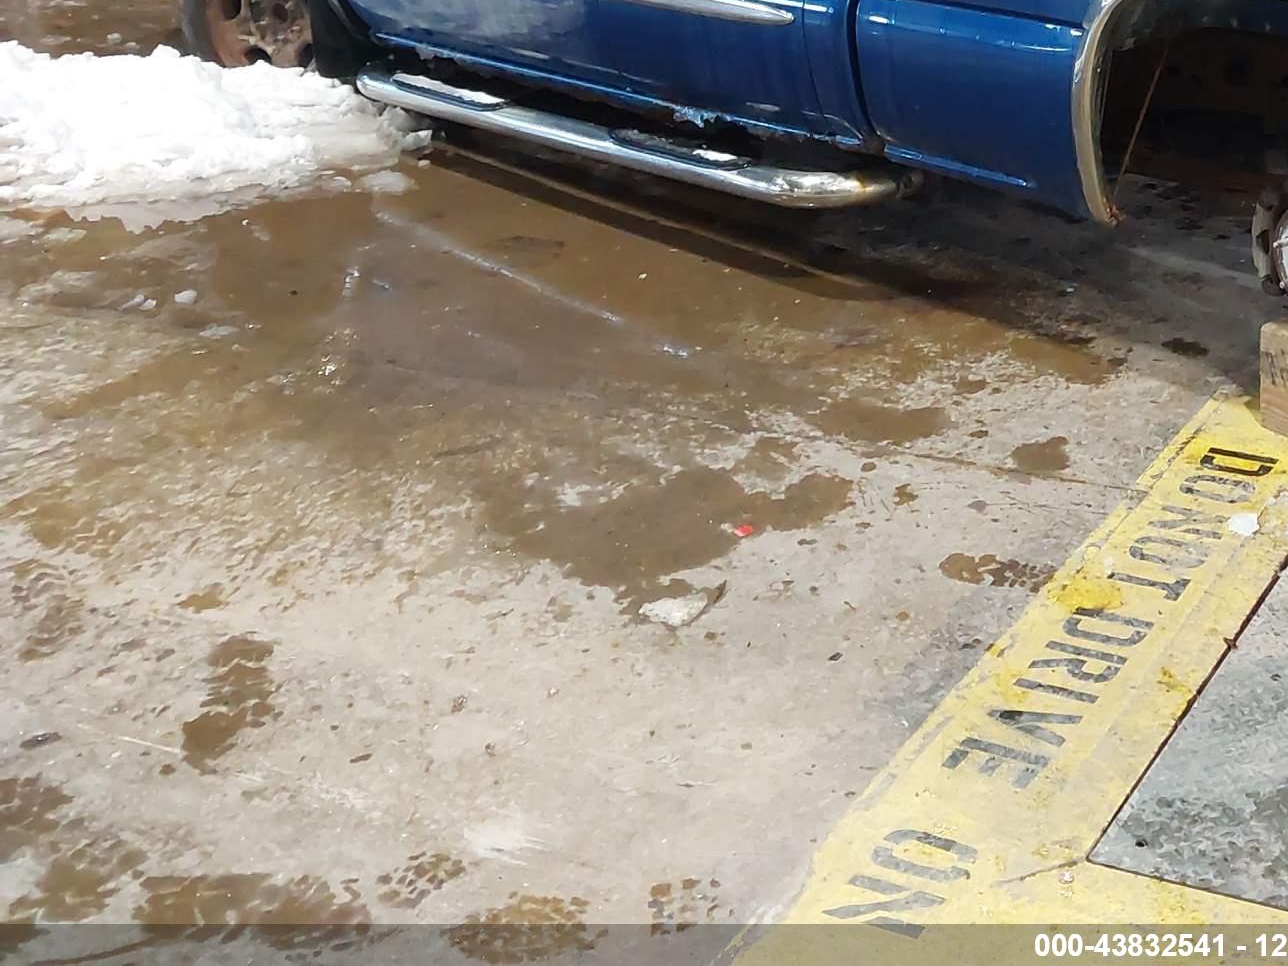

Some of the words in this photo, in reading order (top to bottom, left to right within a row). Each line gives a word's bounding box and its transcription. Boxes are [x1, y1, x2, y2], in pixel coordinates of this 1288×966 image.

[1179, 447, 1279, 504] DO
[1107, 505, 1230, 601] NOT
[942, 607, 1155, 789] DRIVE
[822, 829, 978, 939] ON
